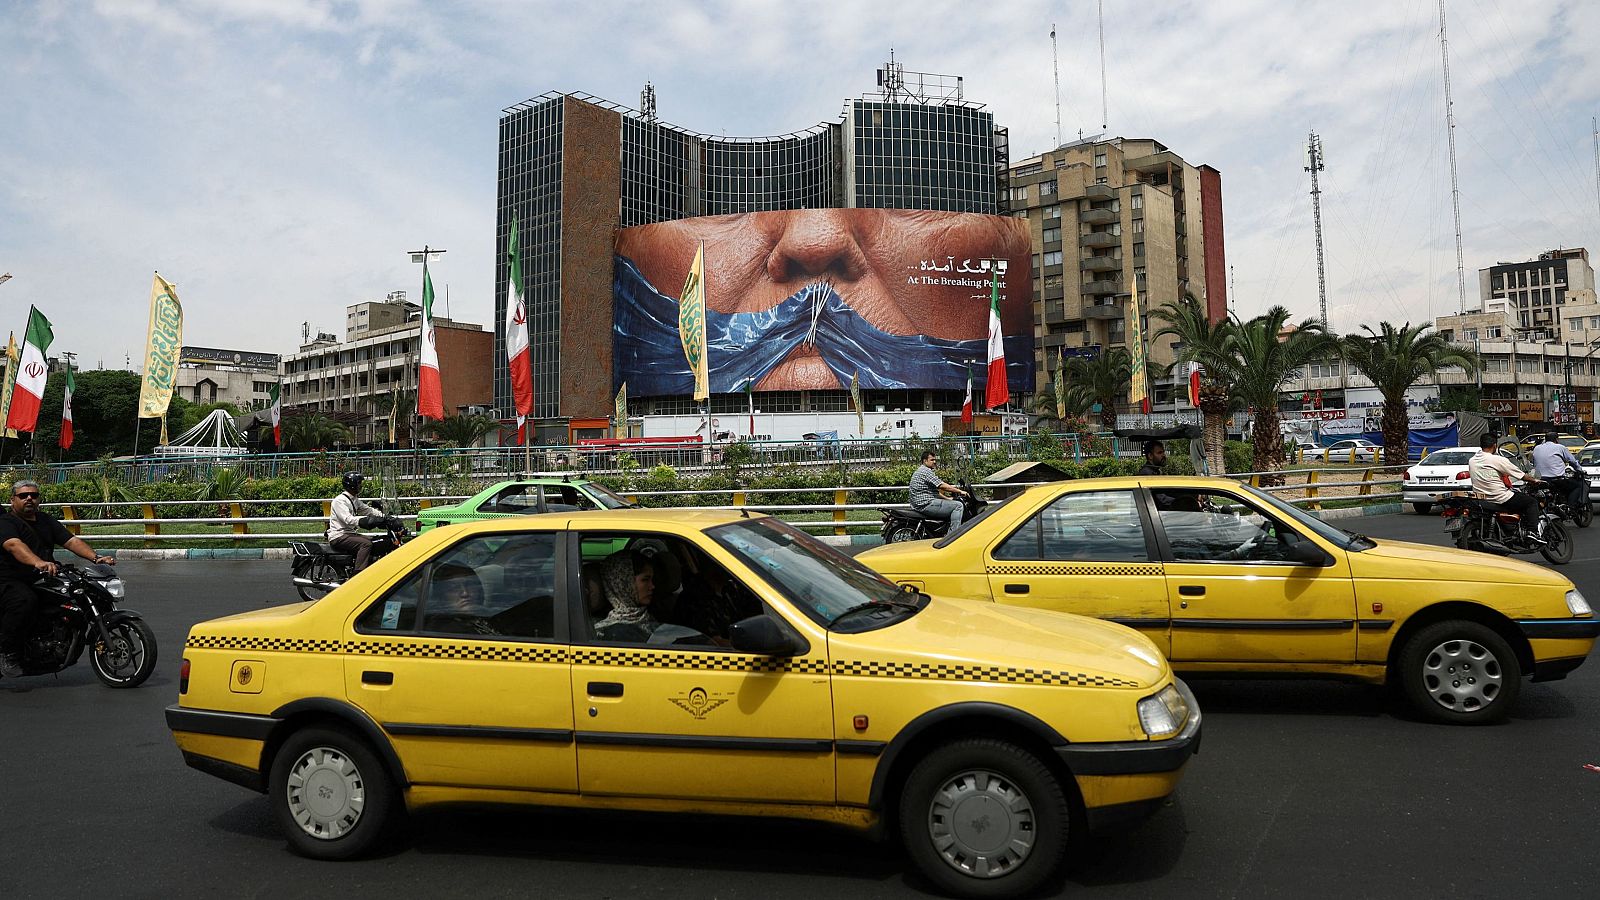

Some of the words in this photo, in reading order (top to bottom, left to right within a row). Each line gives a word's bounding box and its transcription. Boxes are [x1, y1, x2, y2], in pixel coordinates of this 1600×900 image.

[920, 256, 955, 272] آمده
[907, 276, 919, 284] At
[921, 276, 939, 285] The
[941, 277, 982, 289] Breaking
[983, 280, 1006, 289] Pont
